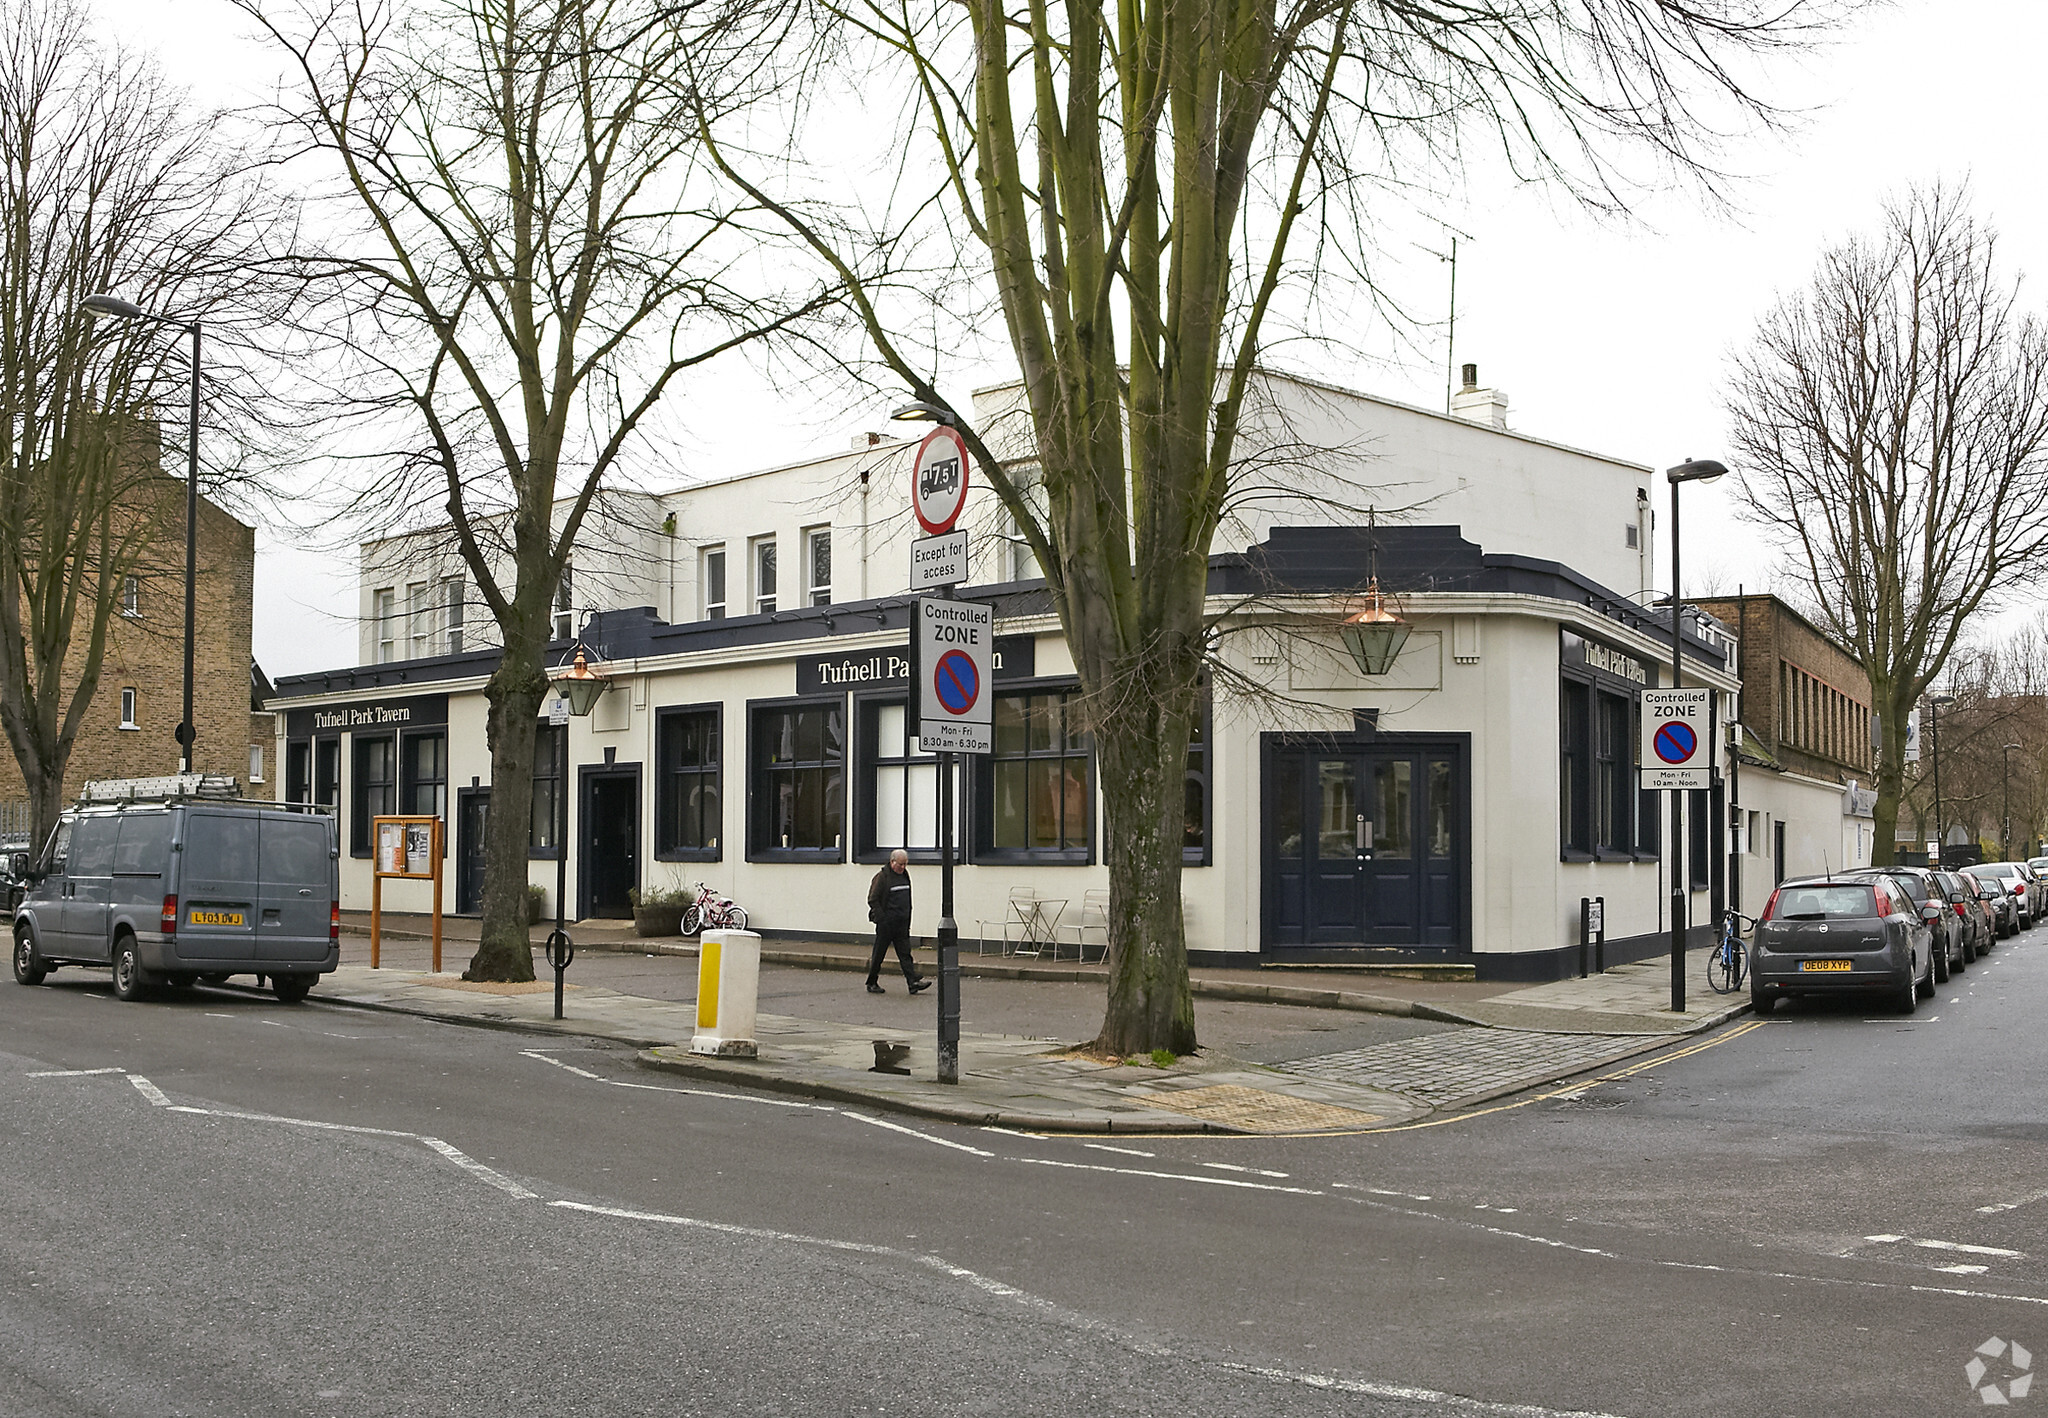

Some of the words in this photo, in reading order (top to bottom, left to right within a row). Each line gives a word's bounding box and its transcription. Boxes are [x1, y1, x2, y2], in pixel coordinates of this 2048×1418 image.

[915, 545, 946, 565] Except
[949, 542, 963, 557] for
[923, 563, 955, 580] access
[925, 604, 988, 624] Controlled
[935, 624, 978, 645] ZONE
[818, 657, 881, 684] Tufnell
[887, 656, 910, 679] Pa
[1645, 693, 1706, 703] Controlled
[314, 710, 348, 728] Tufnell
[350, 707, 374, 725] Park
[375, 706, 410, 723] Tavern
[1654, 705, 1696, 717] ZONE
[941, 725, 957, 735] Mon
[962, 726, 973, 736] Fri
[923, 736, 941, 747] 8.30
[959, 738, 977, 749] 6.30
[978, 742, 989, 750] pm
[1805, 961, 1828, 969] OE08
[1831, 961, 1849, 969] XYP
